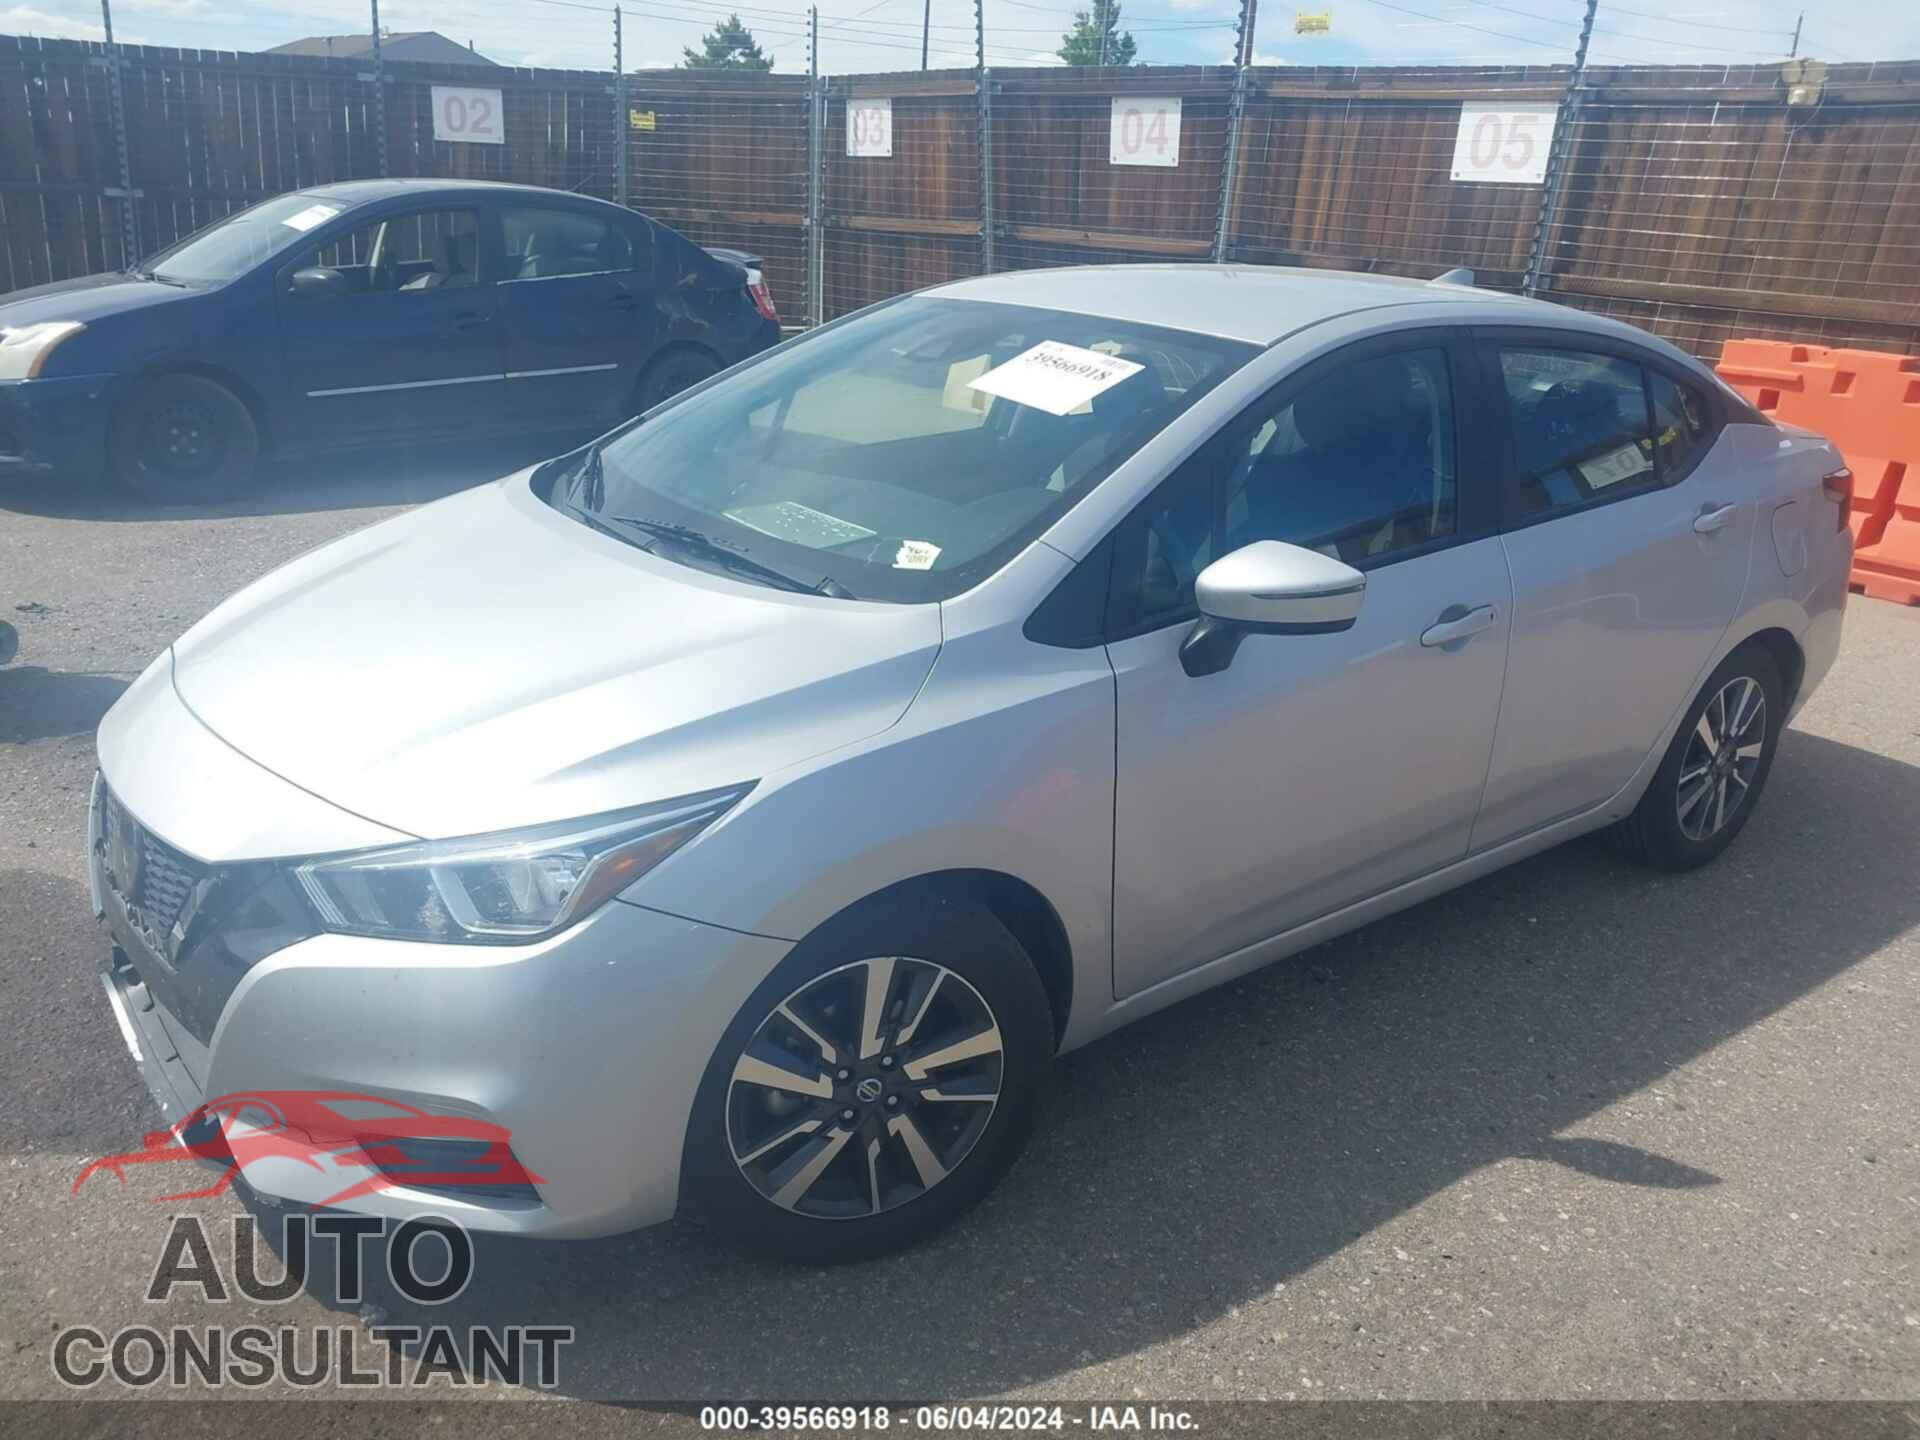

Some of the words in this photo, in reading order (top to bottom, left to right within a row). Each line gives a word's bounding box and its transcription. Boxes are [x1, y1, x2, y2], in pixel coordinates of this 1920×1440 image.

[444, 96, 493, 133] 02
[854, 108, 884, 147] 03
[1121, 108, 1169, 155] 04
[1470, 113, 1538, 170] 05
[1025, 352, 1113, 382] 39566918
